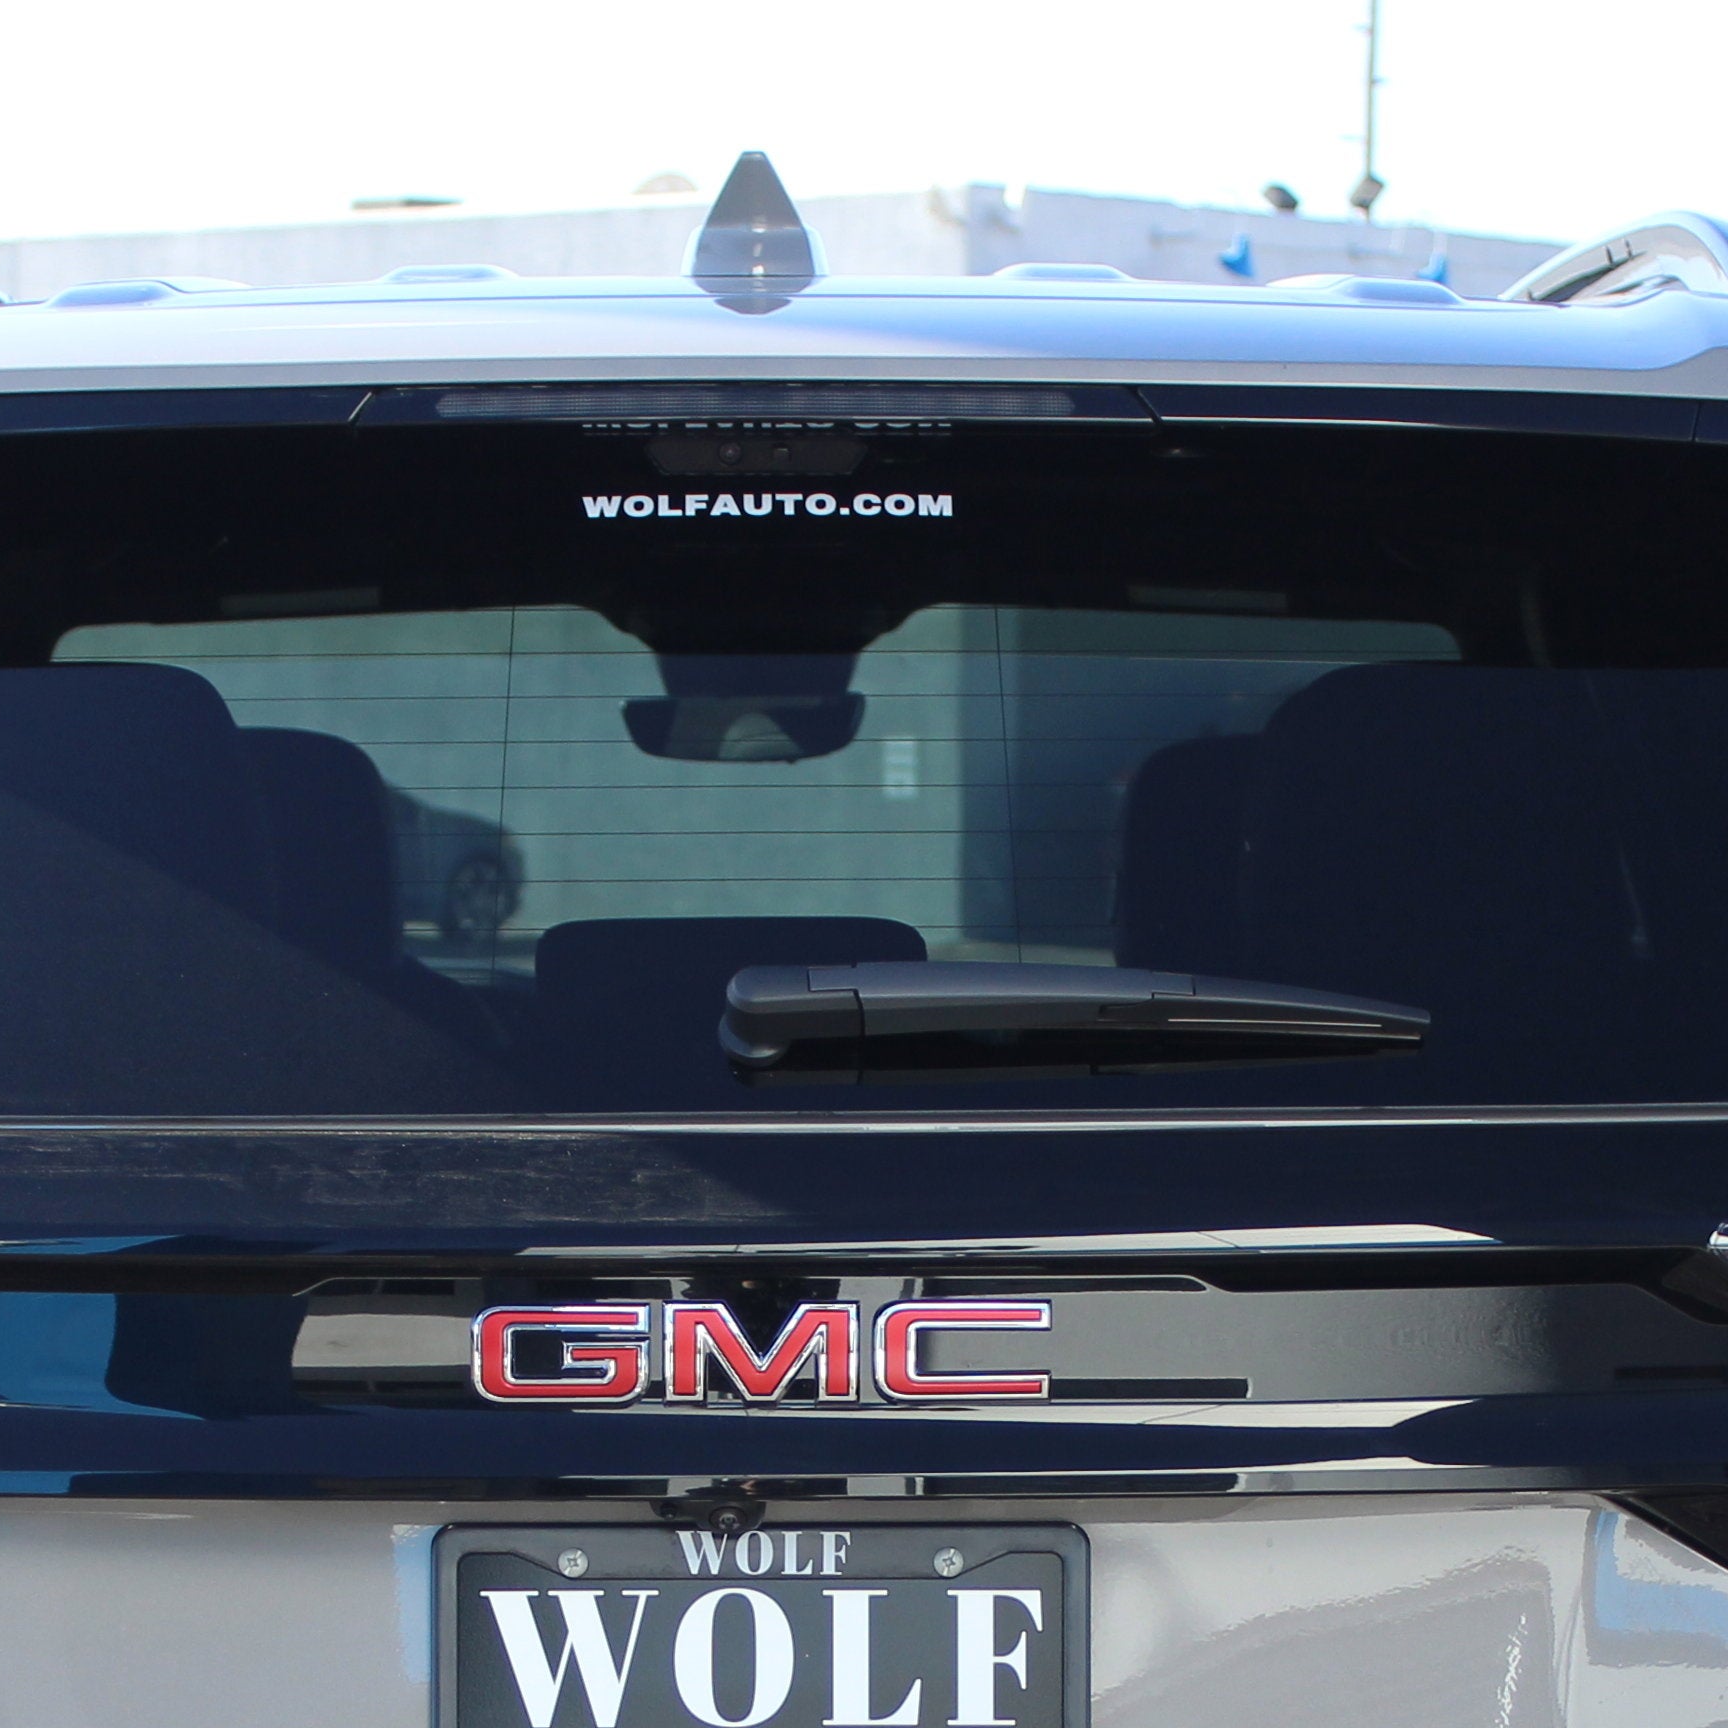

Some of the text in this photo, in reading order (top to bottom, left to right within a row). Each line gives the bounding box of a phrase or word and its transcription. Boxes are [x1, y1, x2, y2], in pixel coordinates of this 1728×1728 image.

[582, 493, 954, 518] WOLFAUTO.COM
[471, 1300, 1052, 1403] GMC
[675, 1530, 852, 1577] WOLF
